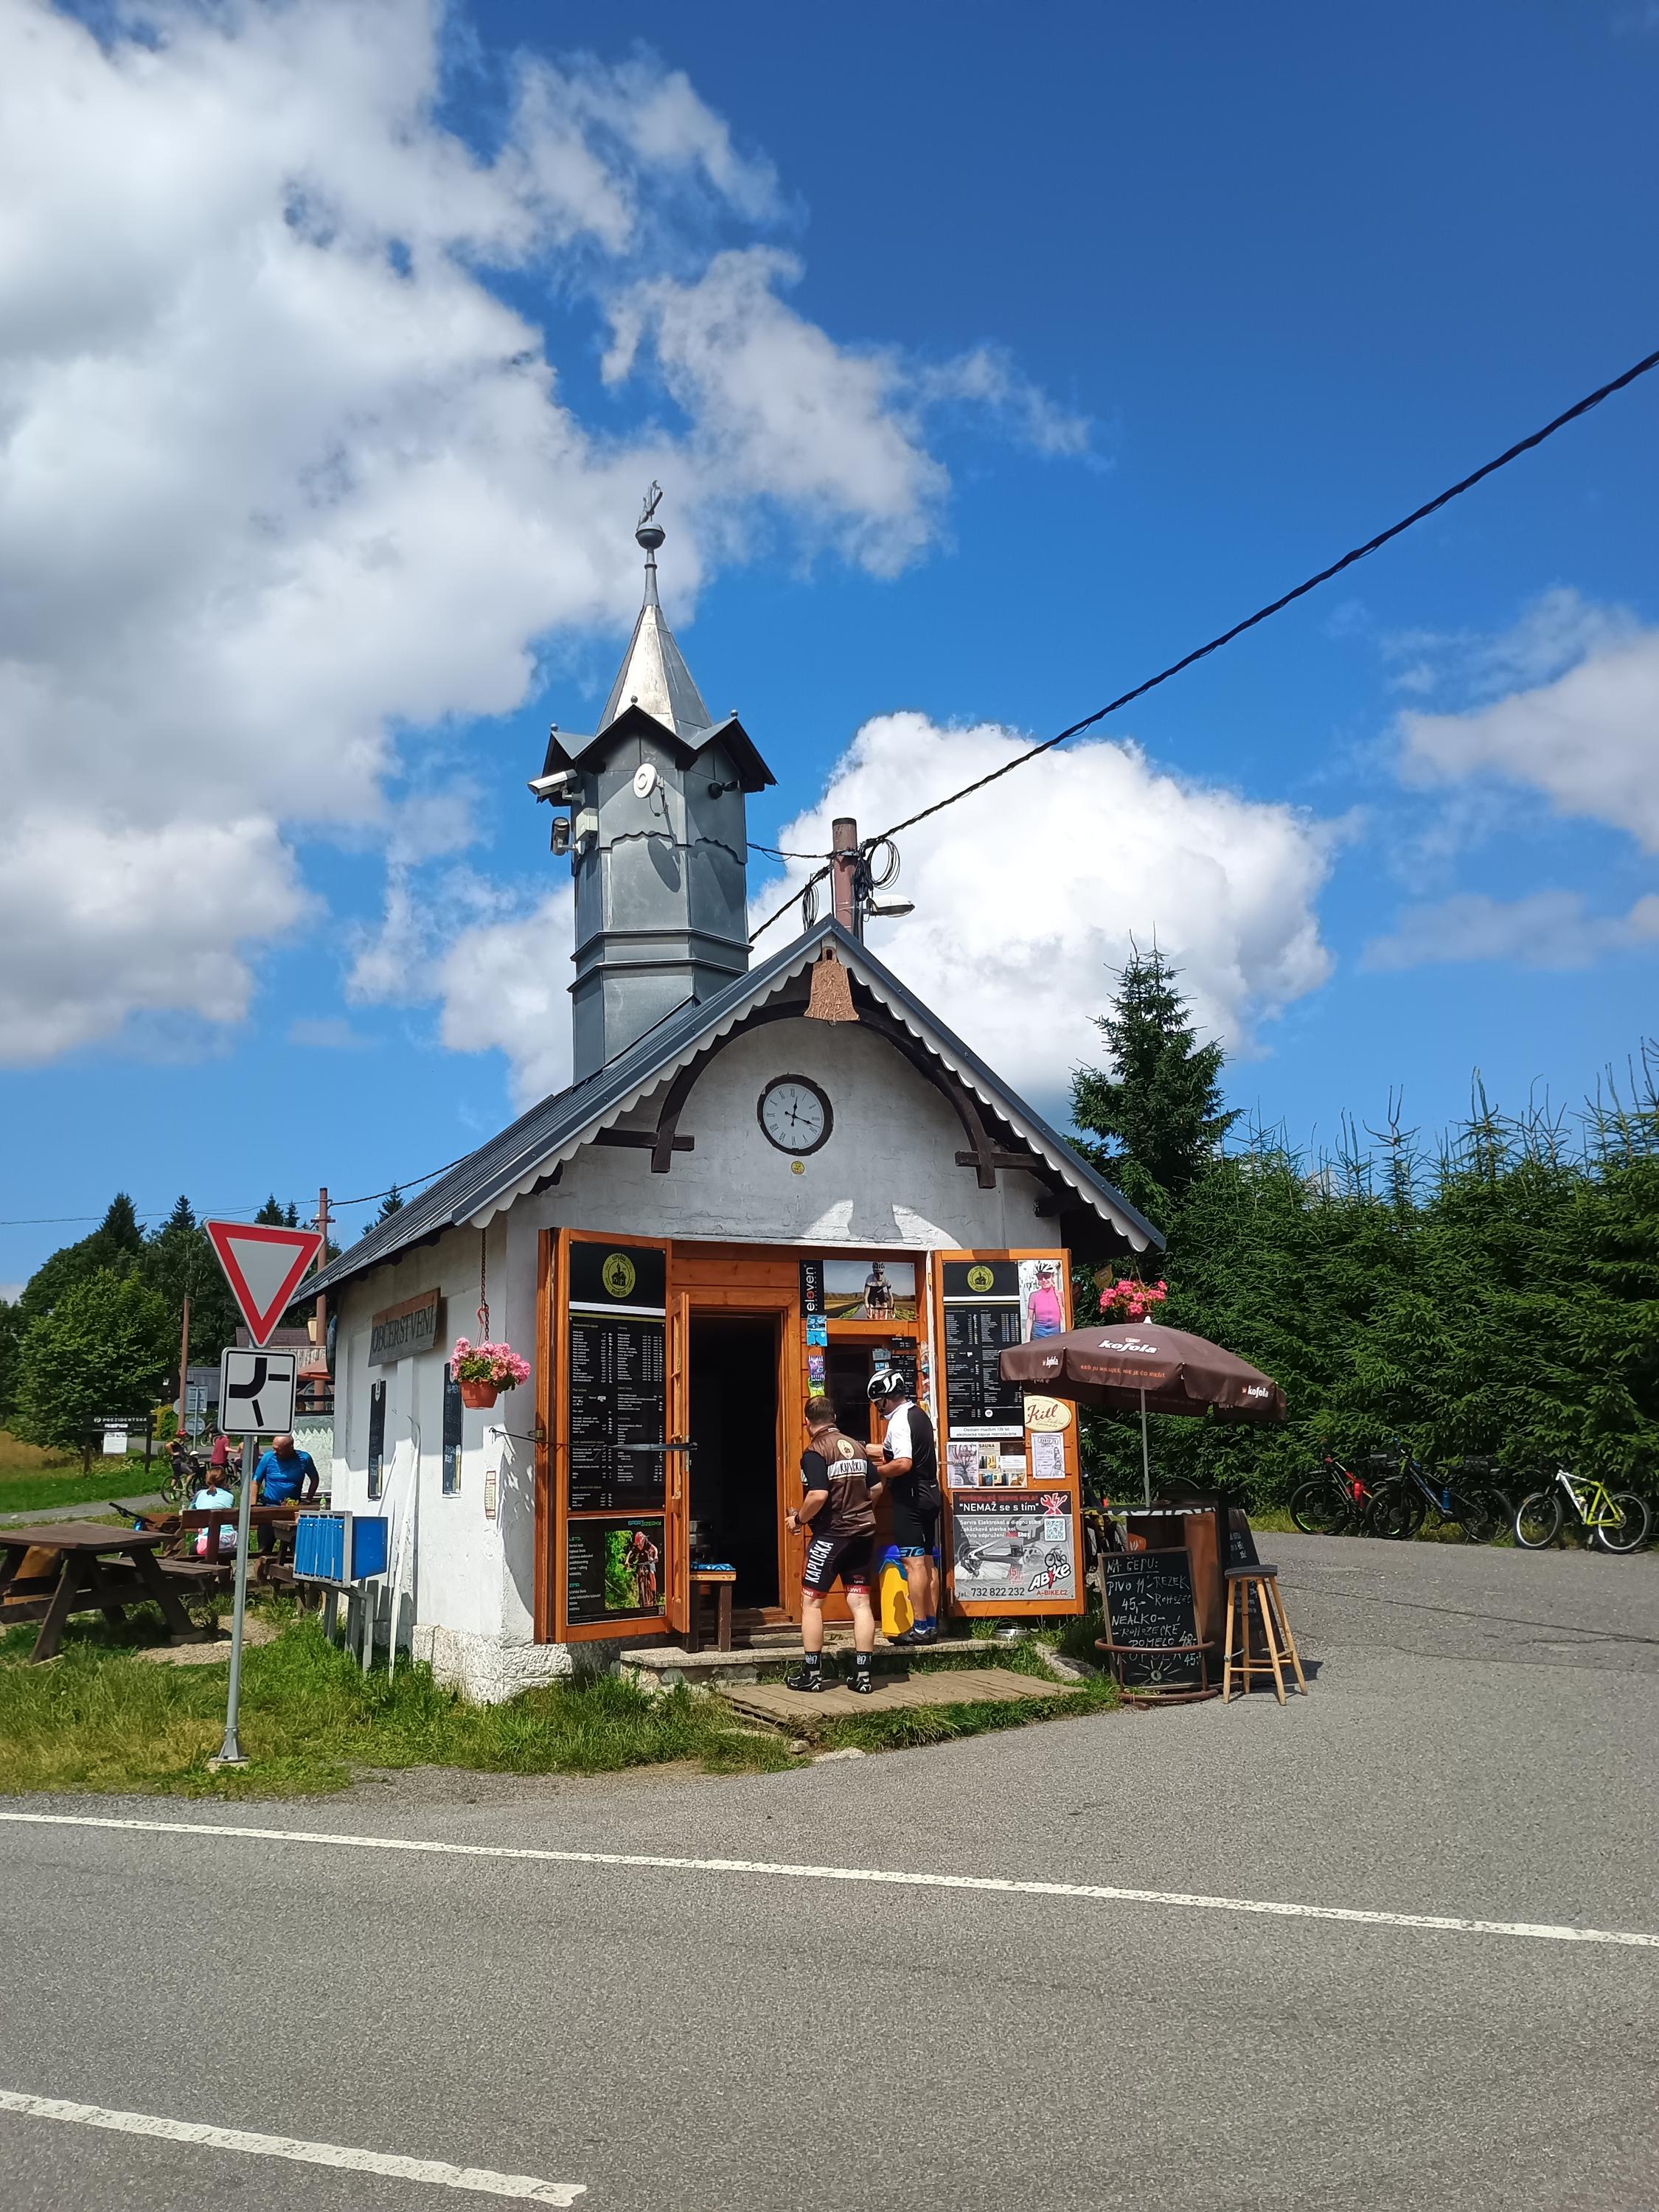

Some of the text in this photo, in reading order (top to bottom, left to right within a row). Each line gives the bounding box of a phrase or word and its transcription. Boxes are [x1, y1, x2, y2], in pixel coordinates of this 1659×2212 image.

[804, 1267, 815, 1312] eleven
[372, 1295, 436, 1354] OBČERSTVENÍ
[1098, 1339, 1158, 1354] kofola
[1247, 1385, 1270, 1398] kofola
[1026, 1403, 1059, 1425] Kitl
[959, 1501, 997, 1512] "NEMAŽ
[1020, 1501, 1039, 1512] tím"
[804, 1540, 834, 1584] KAPLIČKA
[1107, 1557, 1158, 1573] NA ČEPU:
[971, 1588, 987, 1596] 732
[990, 1587, 1006, 1596] 822
[1008, 1587, 1025, 1596] 232
[1106, 1581, 1132, 1596] PIVO
